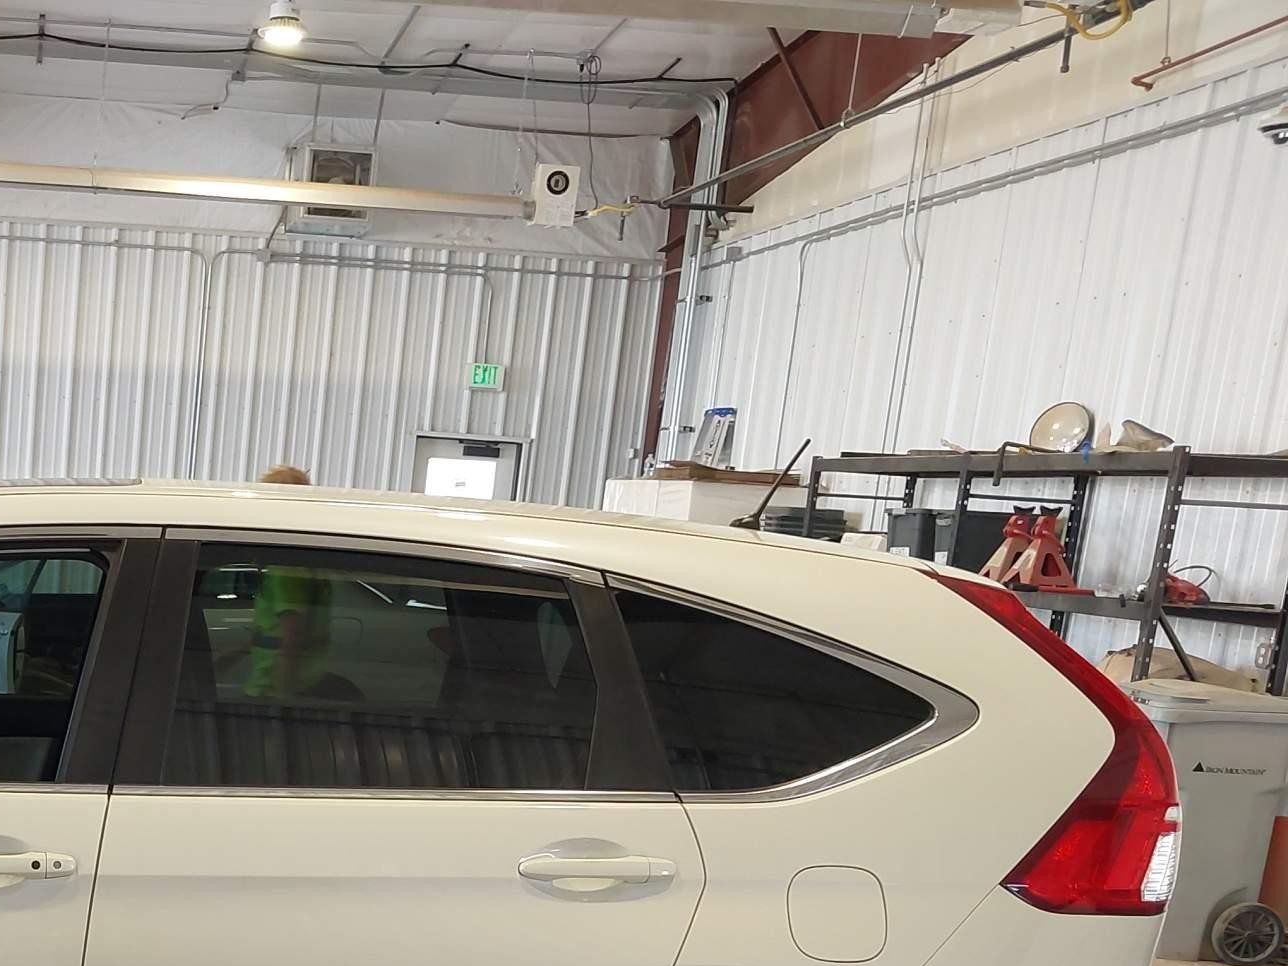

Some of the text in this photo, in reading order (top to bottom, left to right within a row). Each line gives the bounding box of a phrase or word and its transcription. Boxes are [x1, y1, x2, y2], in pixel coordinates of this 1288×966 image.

[473, 365, 499, 384] EXIT
[1206, 766, 1265, 775] IRON MOUNTAIN
